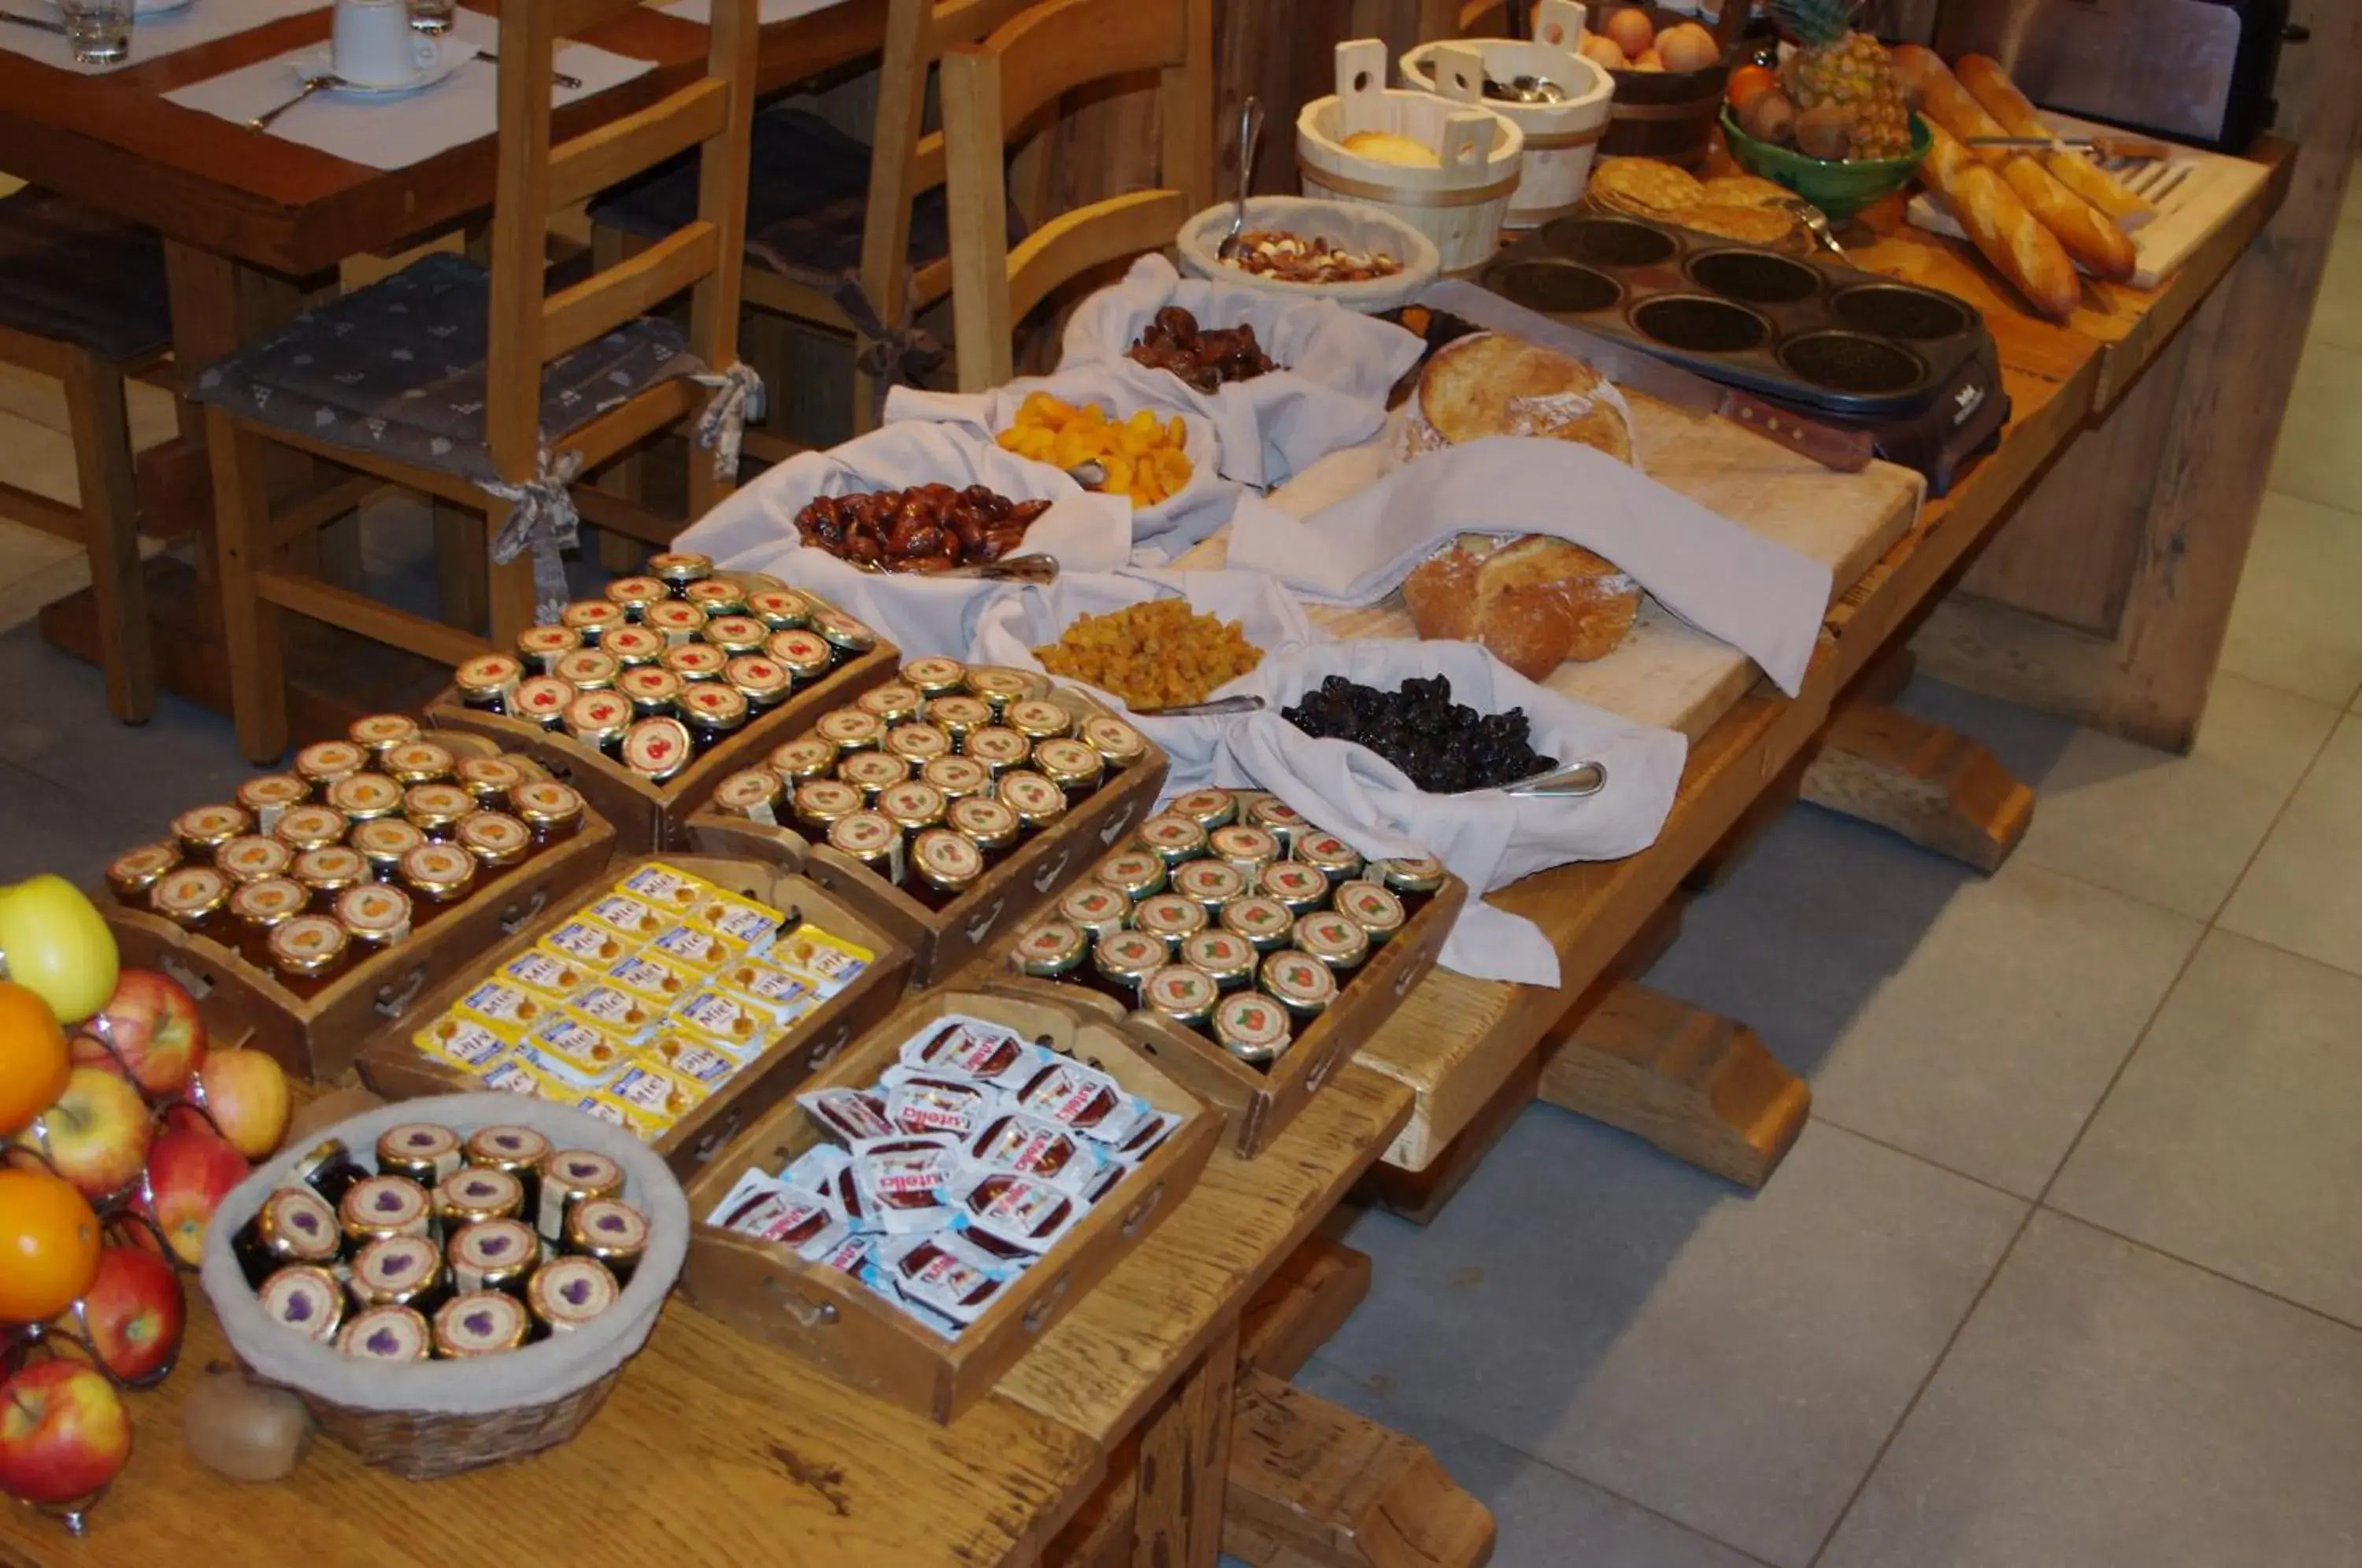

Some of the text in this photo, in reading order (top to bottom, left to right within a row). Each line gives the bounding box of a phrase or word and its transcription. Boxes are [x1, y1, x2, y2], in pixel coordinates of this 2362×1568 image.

[590, 990, 626, 1015] Miel
[699, 998, 733, 1026] Miel
[558, 1028, 595, 1051] Miel
[630, 1074, 665, 1104] Miel
[1055, 1081, 1098, 1120] nutella
[903, 1106, 972, 1129] nutella
[1014, 1129, 1053, 1170] nutella
[880, 1172, 950, 1193] nutella
